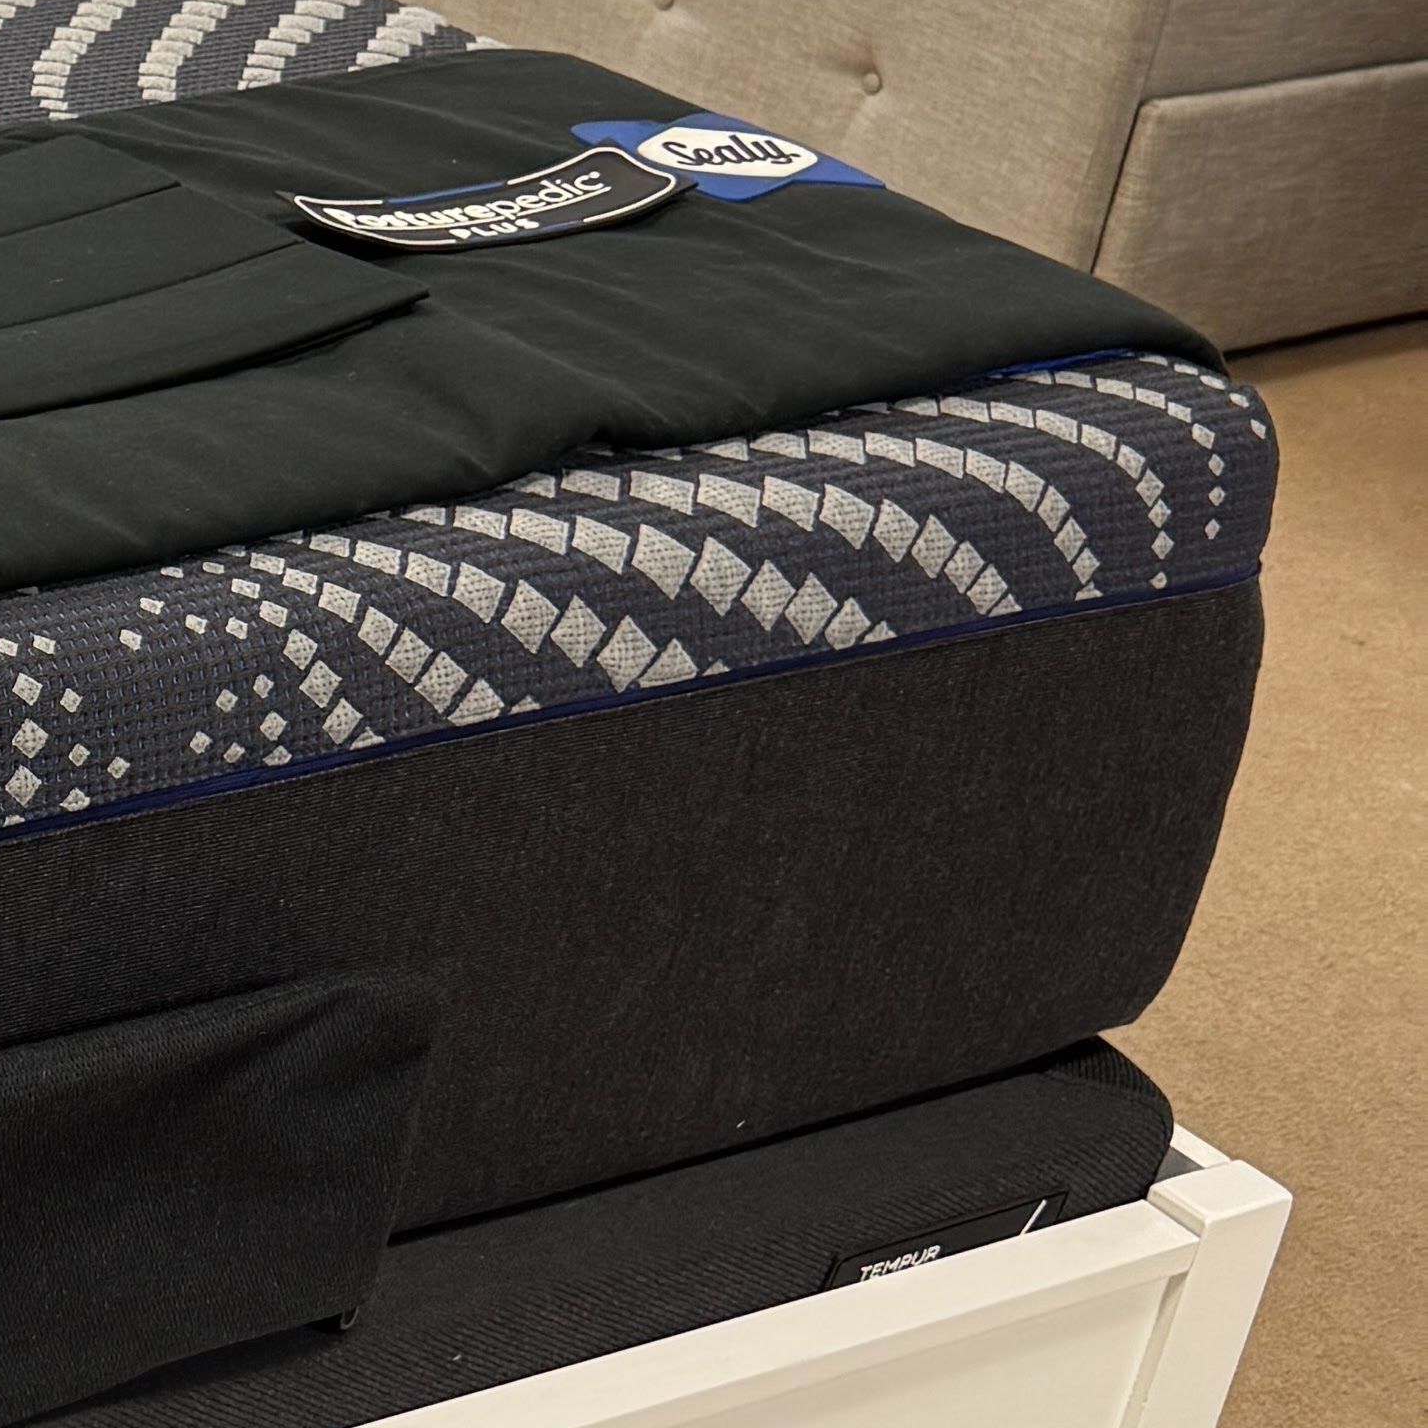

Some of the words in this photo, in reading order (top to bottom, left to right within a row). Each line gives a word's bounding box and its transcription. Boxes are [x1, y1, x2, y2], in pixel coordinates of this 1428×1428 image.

[662, 134, 797, 166] Sealy
[323, 173, 605, 228] Posturepedic
[448, 219, 540, 240] PLUS
[859, 1244, 941, 1282] TEMPUR
